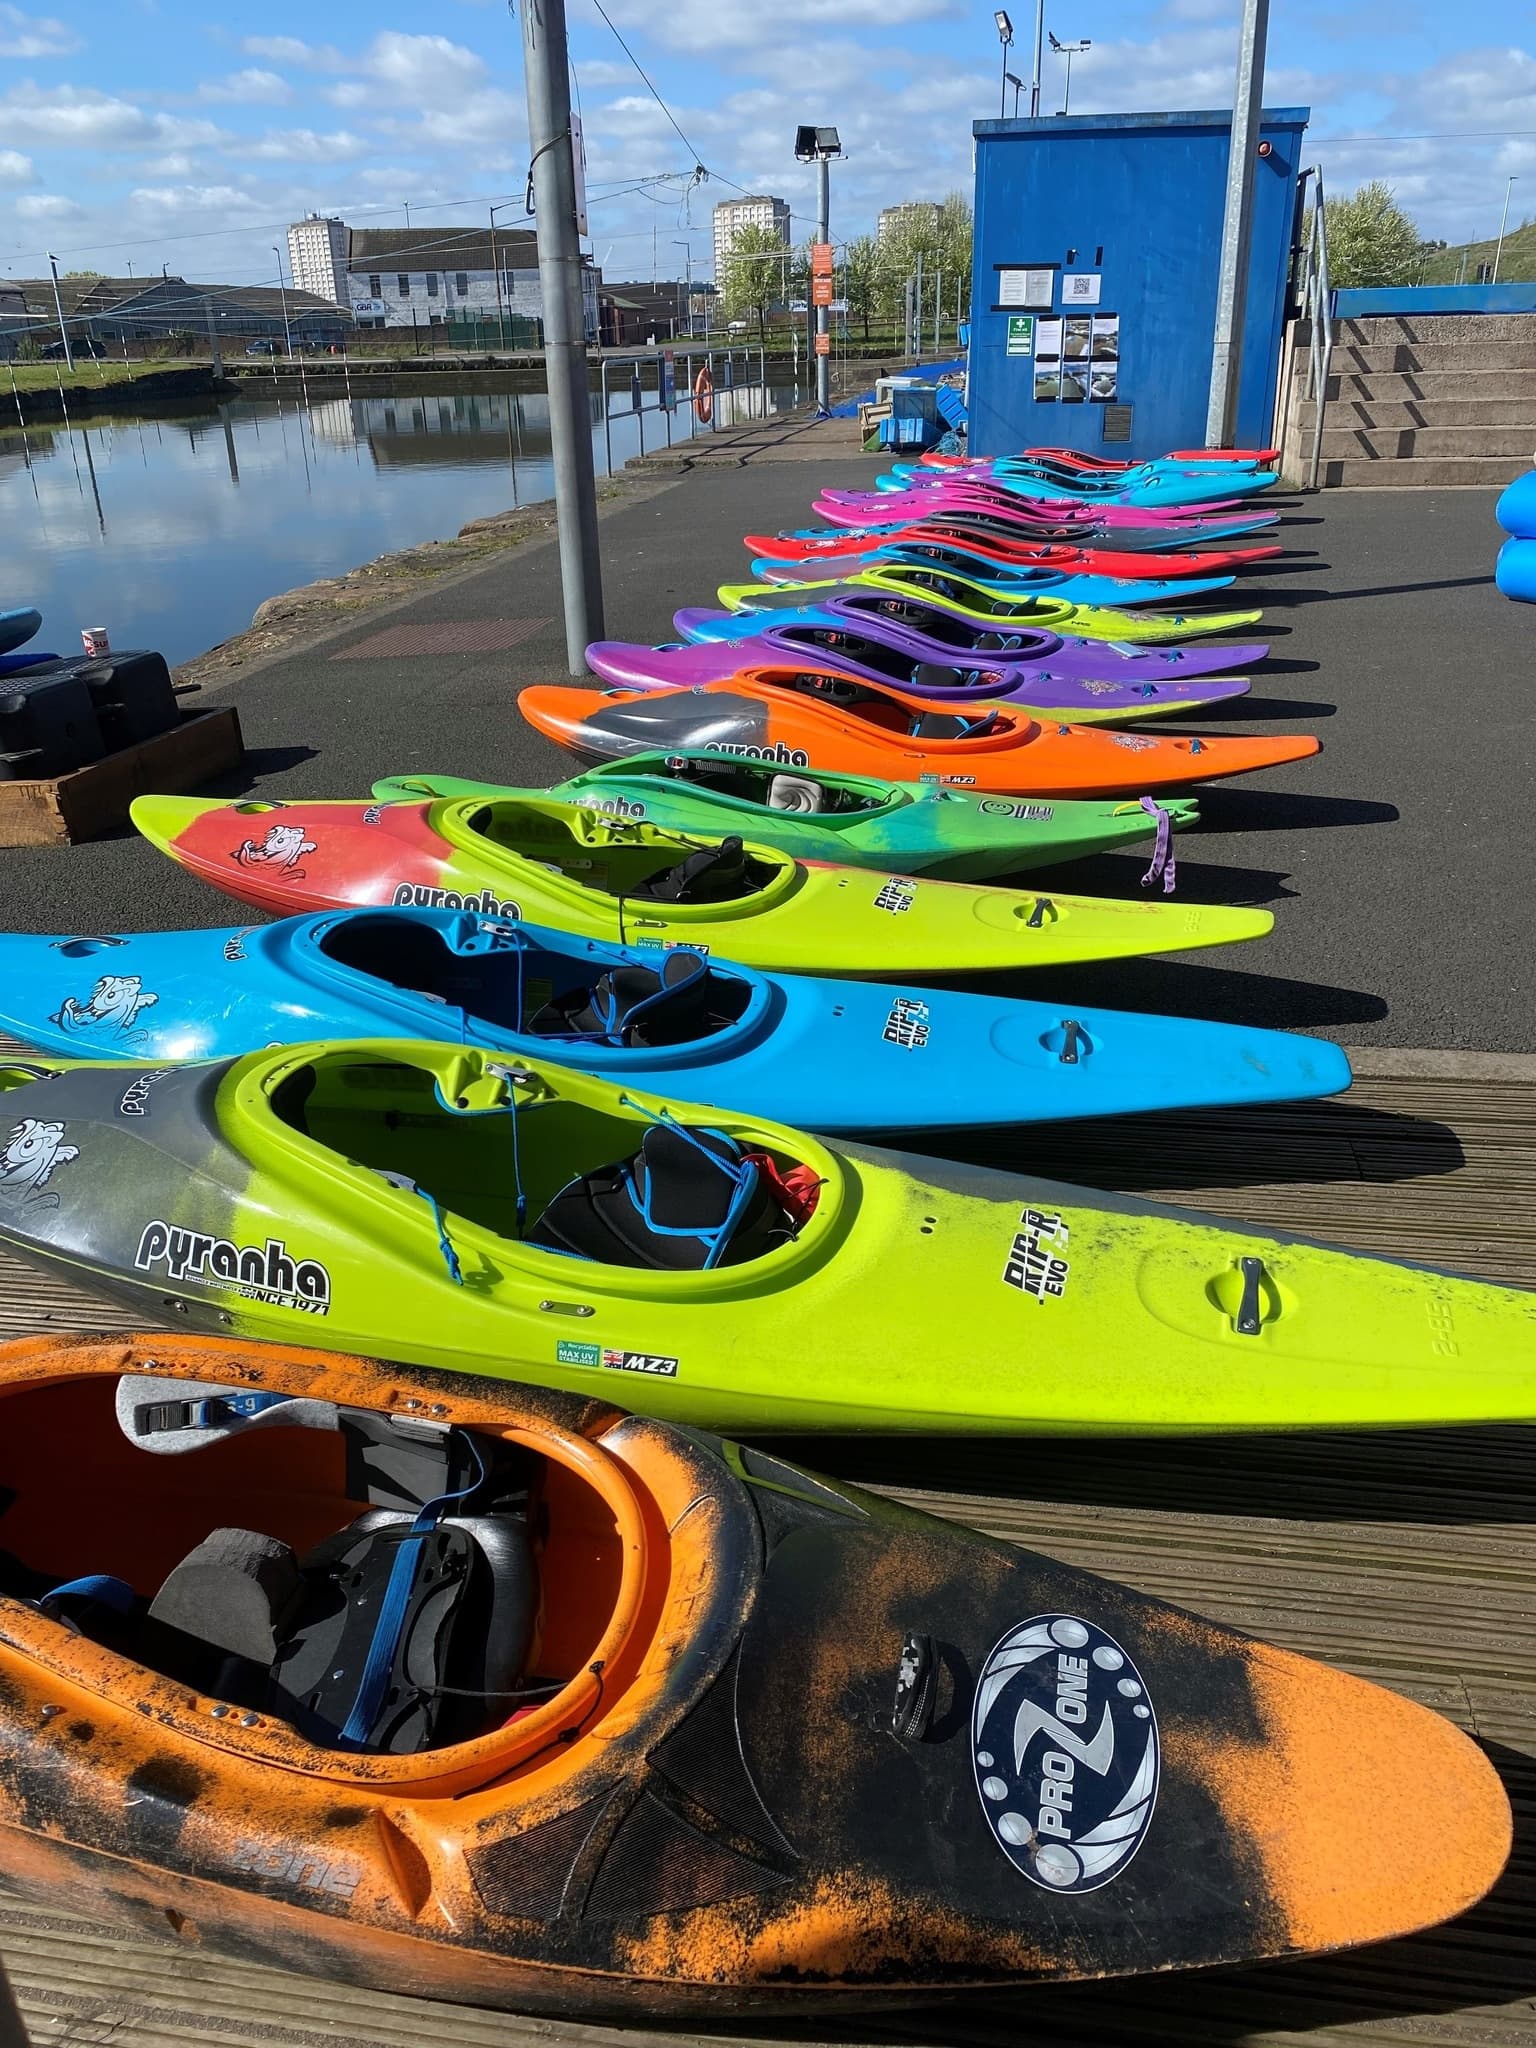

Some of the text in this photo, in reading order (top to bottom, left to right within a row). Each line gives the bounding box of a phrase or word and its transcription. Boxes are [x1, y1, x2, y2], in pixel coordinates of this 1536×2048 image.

[951, 776, 975, 784] MZ3
[897, 895, 914, 911] EVO
[913, 1025, 929, 1046] EVO
[135, 1220, 330, 1303] pyranha
[1044, 1259, 1069, 1297] EVO
[239, 1287, 288, 1307] SINCE
[290, 1298, 329, 1316] 1971
[558, 1349, 579, 1358] MAX
[625, 1355, 676, 1374] MZ3
